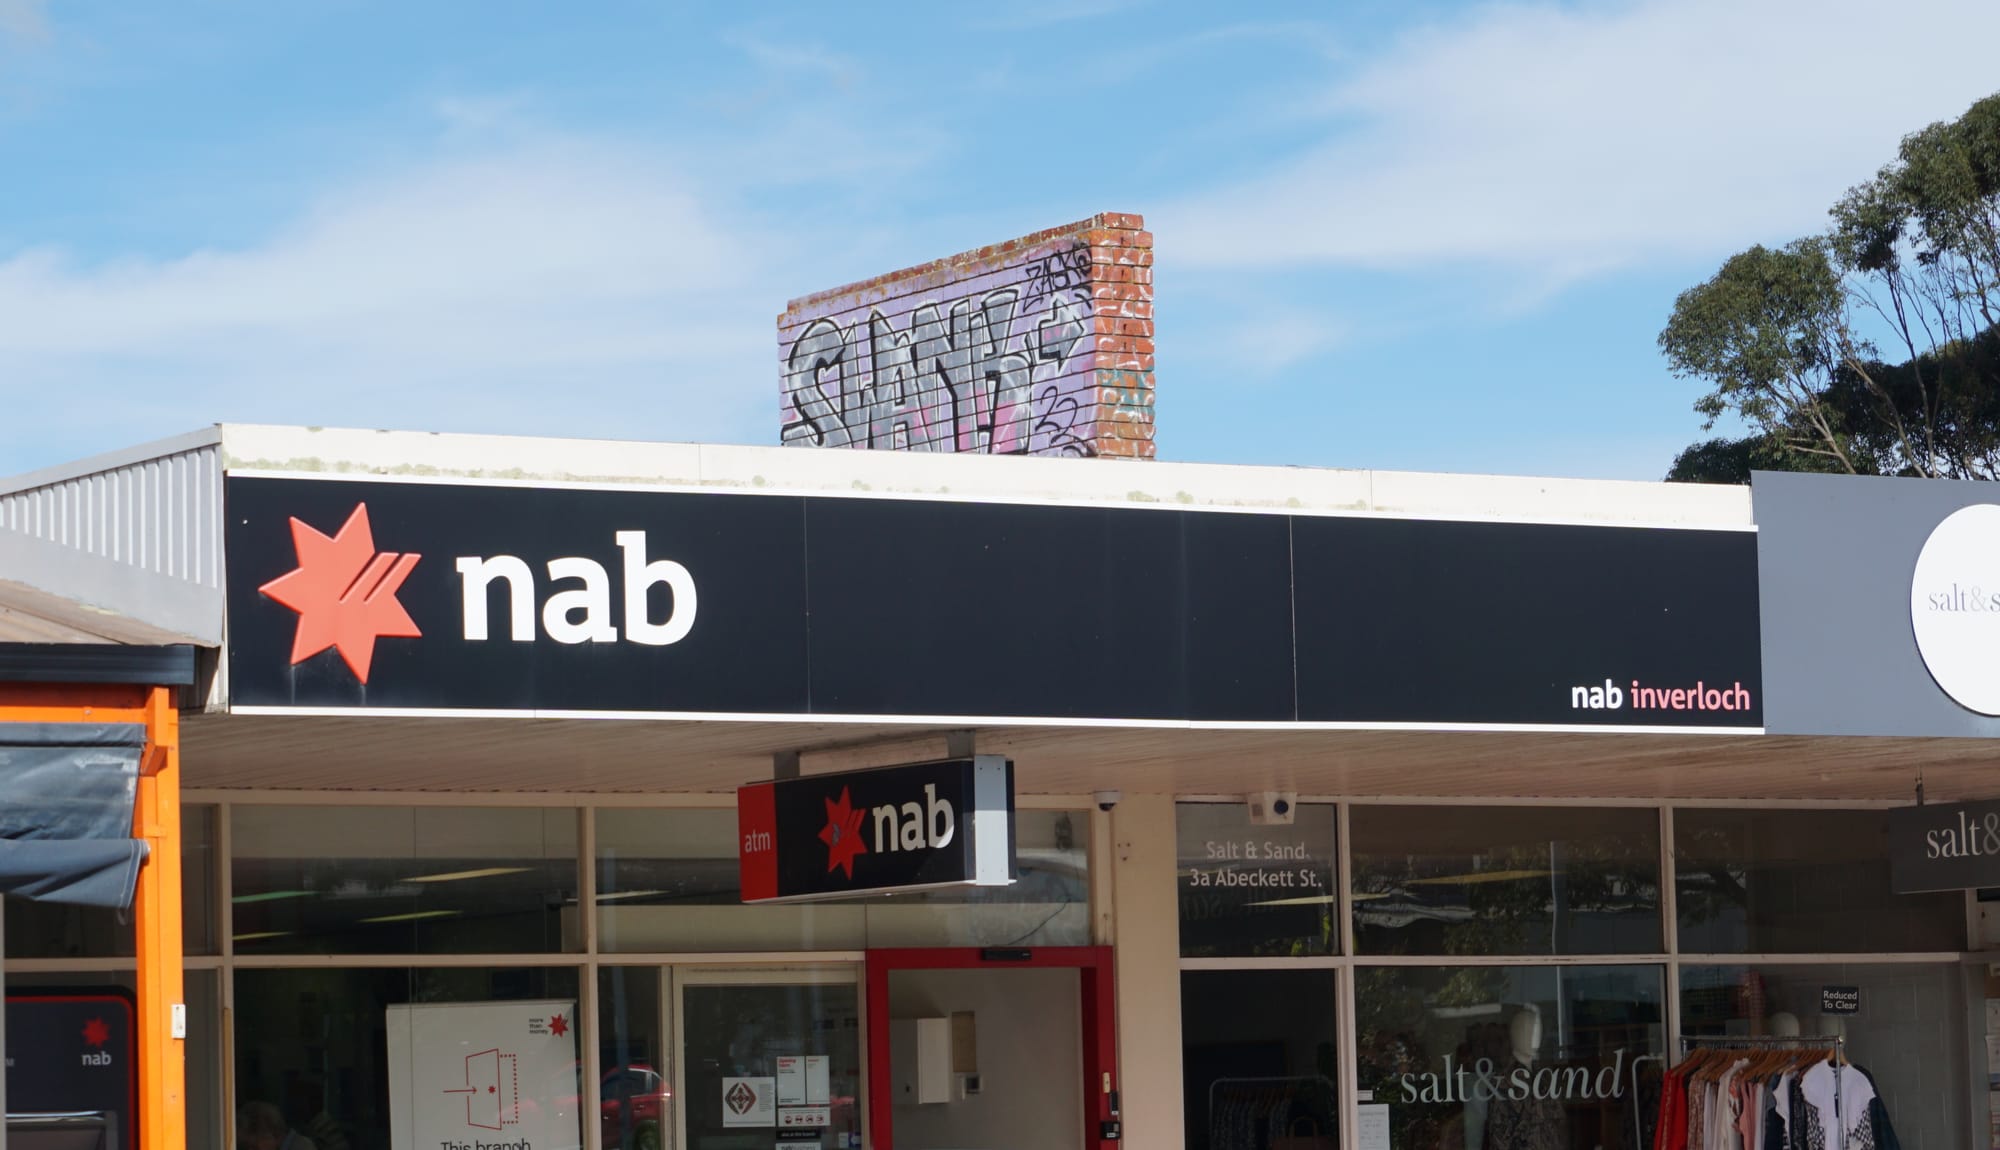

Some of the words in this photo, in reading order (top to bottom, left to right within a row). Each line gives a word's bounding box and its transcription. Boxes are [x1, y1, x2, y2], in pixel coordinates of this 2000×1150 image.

[455, 530, 698, 646] nab
[1571, 679, 1623, 710] nab
[1631, 680, 1751, 711] inverloch
[872, 783, 955, 853] nab
[744, 830, 771, 853] atm
[1206, 841, 1239, 859] Salt
[1245, 841, 1258, 859] &
[1189, 869, 1210, 887] 3a
[1215, 868, 1295, 887] Abeckett
[1299, 869, 1323, 887] St.
[1823, 990, 1858, 1000] Reduced
[1823, 1000, 1834, 1009] To
[1835, 1000, 1857, 1009] Clear
[81, 1051, 112, 1067] nab
[1401, 1048, 1625, 1104] salt&sand
